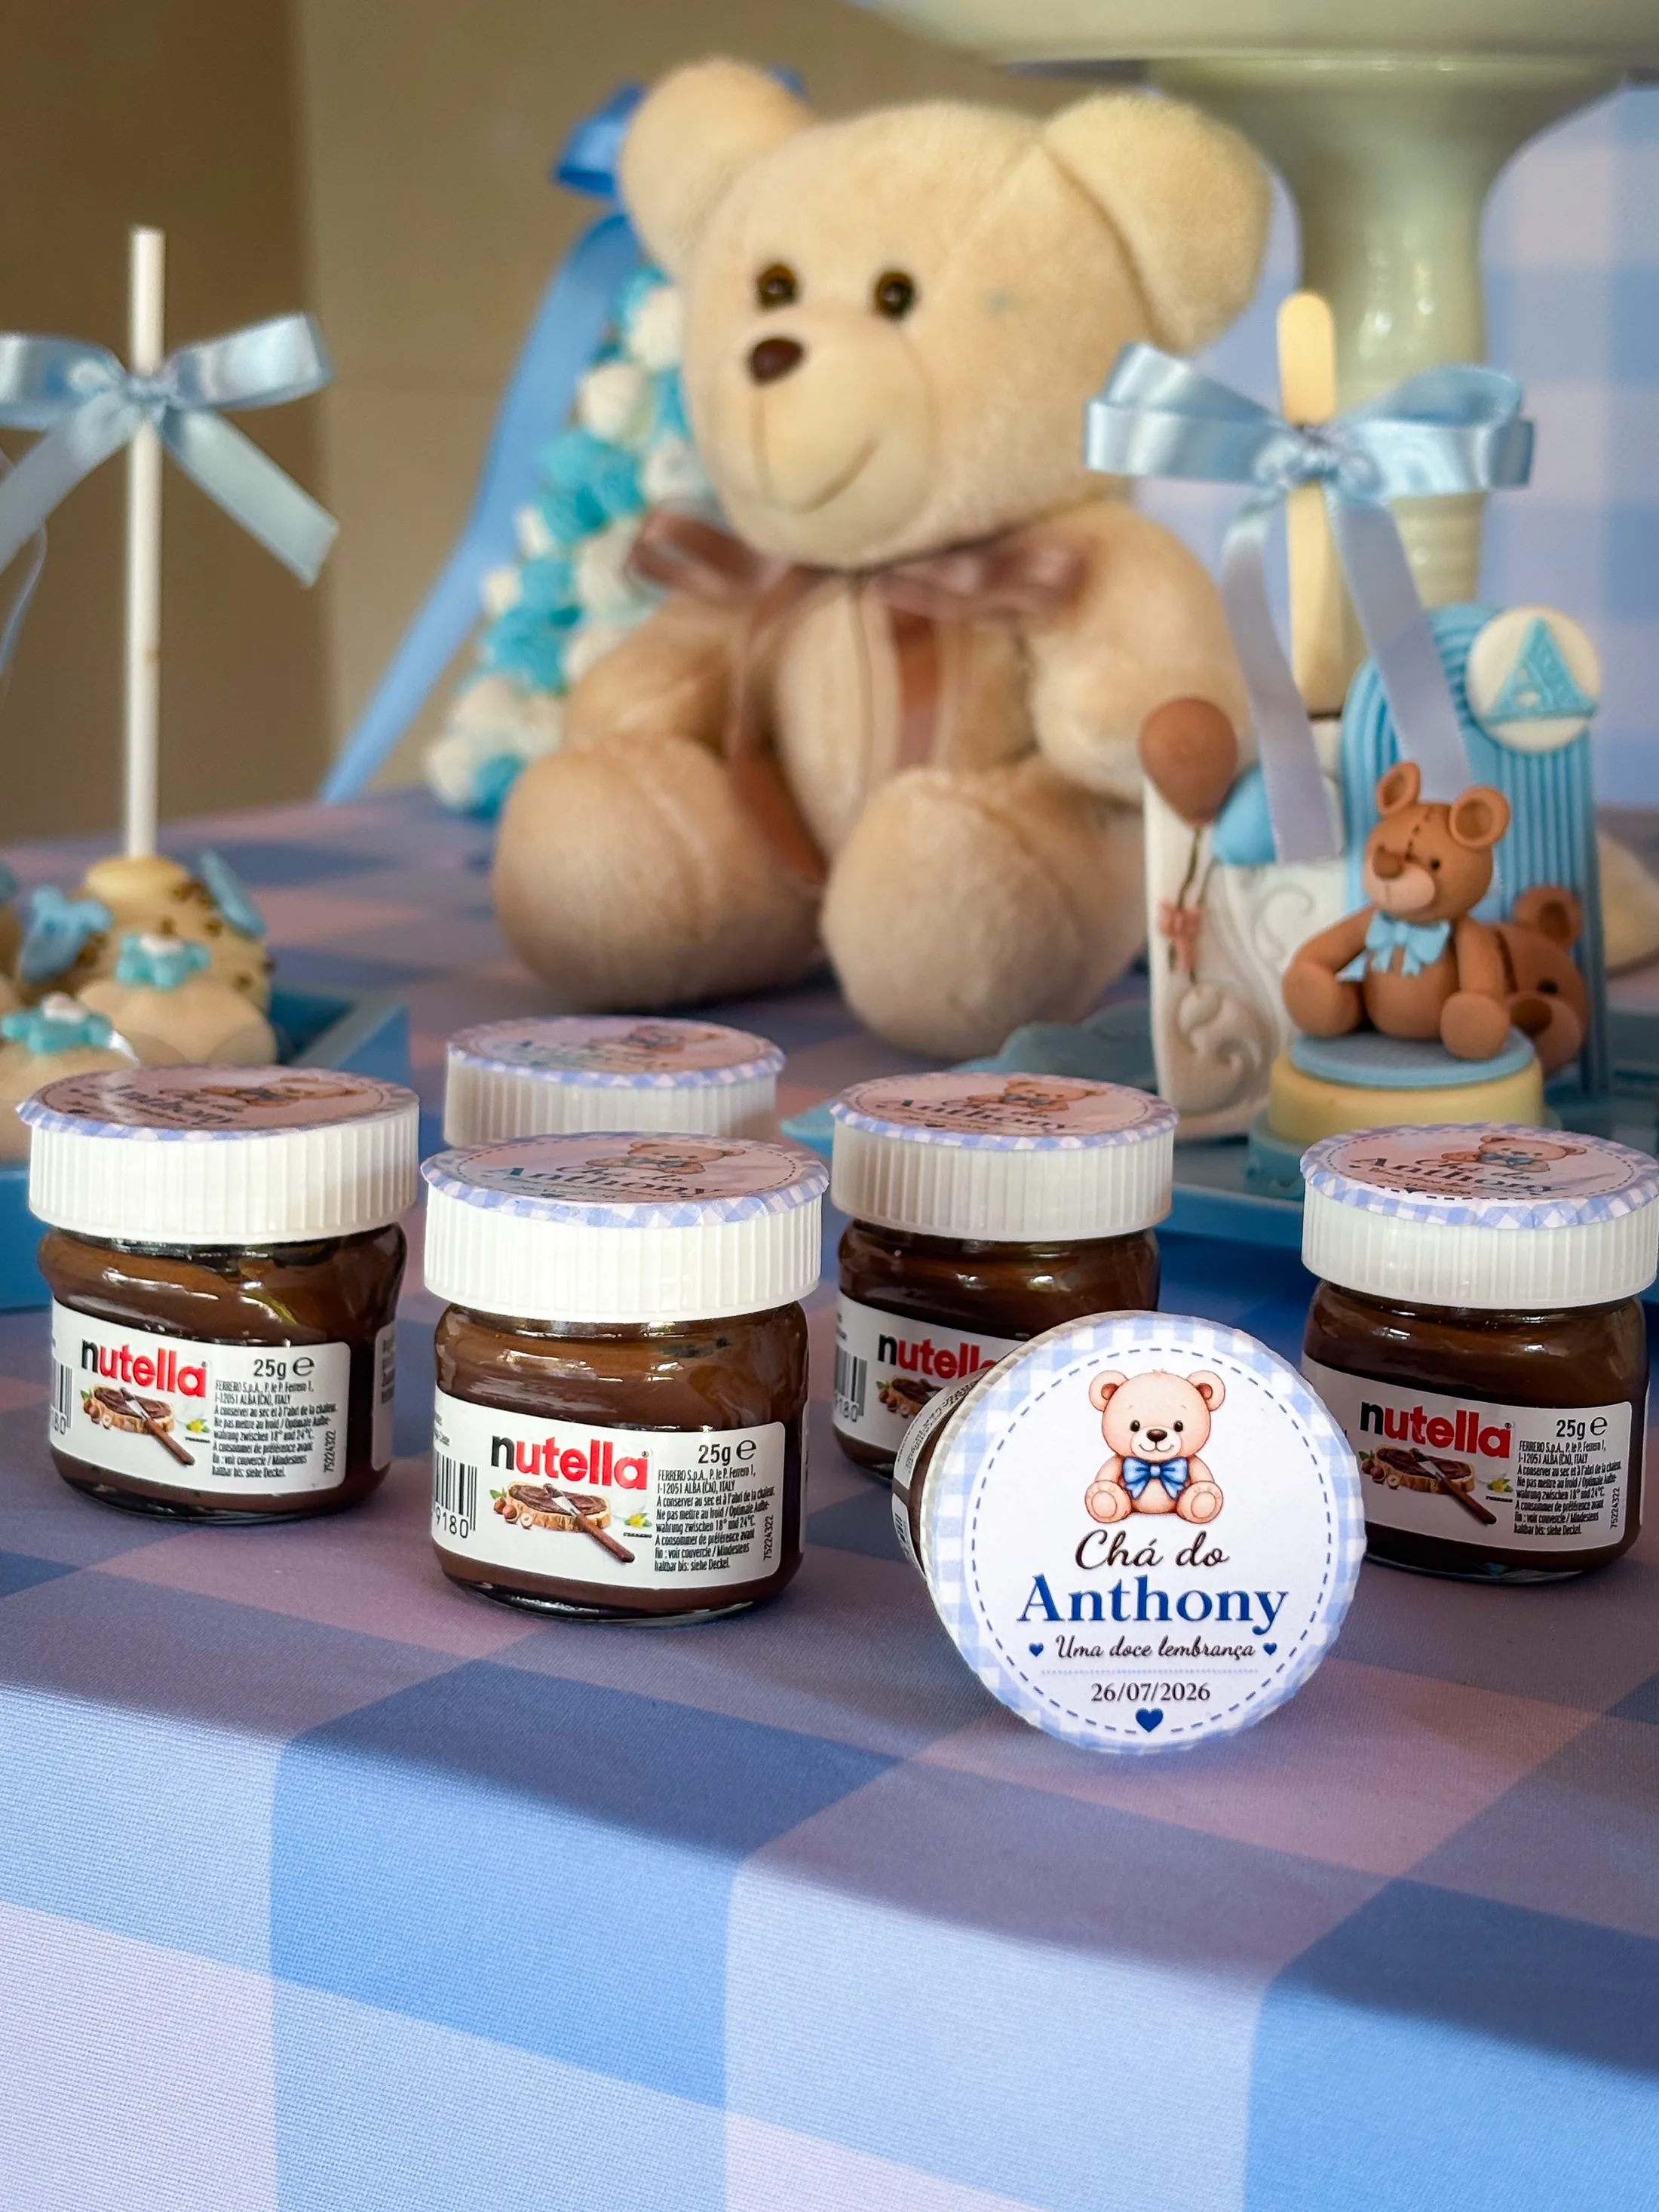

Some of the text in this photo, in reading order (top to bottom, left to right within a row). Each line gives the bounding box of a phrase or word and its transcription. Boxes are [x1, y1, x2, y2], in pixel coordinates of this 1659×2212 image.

[1488, 616, 1599, 724] A
[483, 1167, 723, 1195] Anthony
[1349, 1157, 1568, 1192] Anthony
[878, 1333, 997, 1379] nutell
[81, 1339, 207, 1397] nutella
[253, 1359, 287, 1380] 25g
[1360, 1401, 1511, 1459] nutella
[1556, 1419, 1586, 1440] 25g
[698, 1444, 731, 1466] 25g
[1519, 1440, 1544, 1453] FERRERO
[491, 1435, 648, 1489] nutella
[1543, 1454, 1558, 1465] ALBA
[1575, 1453, 1588, 1464] ITALY
[658, 1469, 685, 1481] FERRERO
[710, 1470, 715, 1480] P.
[723, 1468, 728, 1479] P.
[729, 1467, 749, 1479] Ferrero
[1517, 1477, 1525, 1486] Ne
[1526, 1478, 1537, 1489] pas
[684, 1482, 701, 1493] ALBA
[719, 1480, 735, 1492] ITALY
[663, 1496, 693, 1506] conserver
[695, 1497, 703, 1506] au
[704, 1496, 714, 1505] sec
[1609, 1486, 1620, 1529] 75224322
[435, 1505, 468, 1539] 9180
[657, 1509, 665, 1520] Ne
[667, 1510, 678, 1523] pas
[701, 1509, 709, 1519] au
[685, 1522, 713, 1532] zwischen
[698, 1534, 707, 1545] de
[763, 1515, 774, 1561] 75224322
[668, 1548, 679, 1558] voir
[1075, 1529, 1230, 1569] Chá do
[691, 1560, 707, 1571] siehe
[1016, 1573, 1289, 1636] Anthony
[1055, 1634, 1256, 1661] Uma doce lembrança
[1090, 1682, 1211, 1702] 26/07/2026
